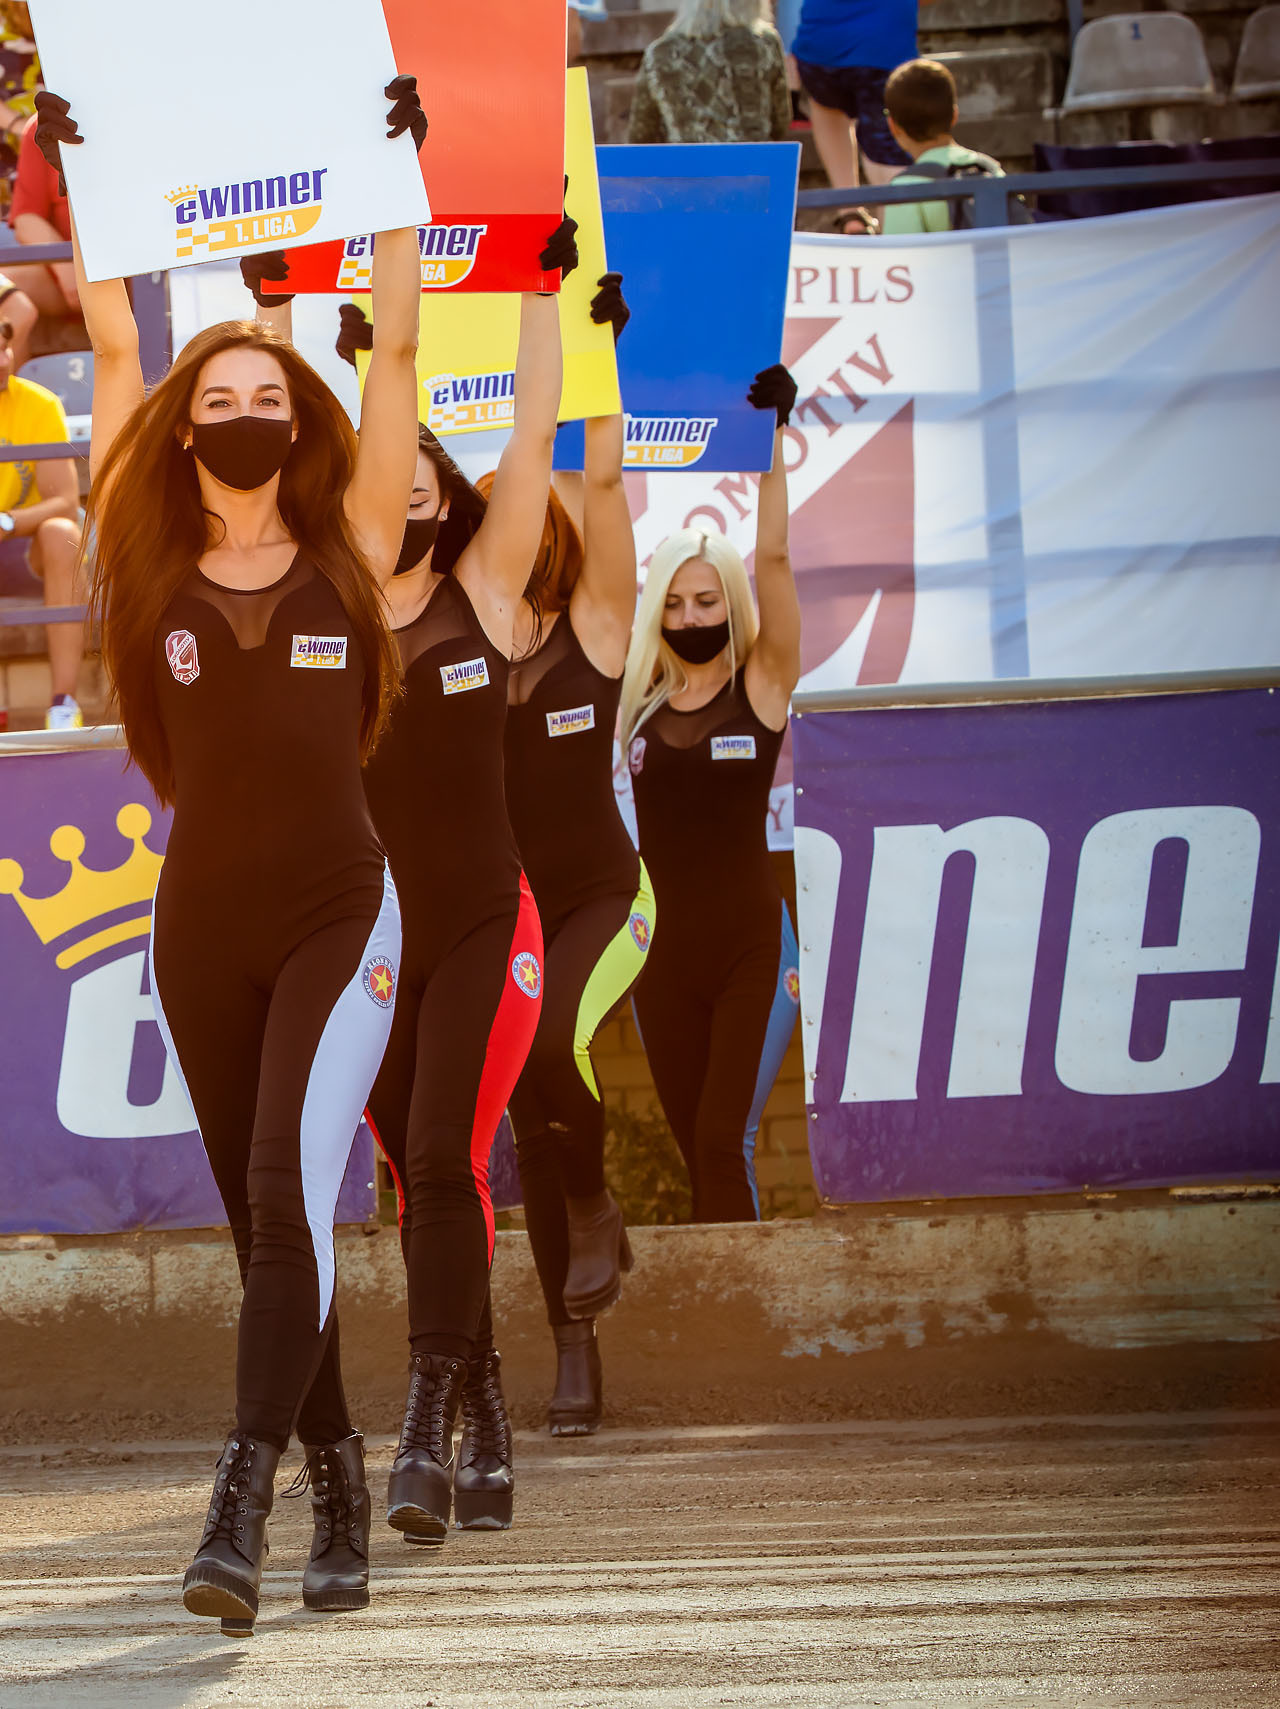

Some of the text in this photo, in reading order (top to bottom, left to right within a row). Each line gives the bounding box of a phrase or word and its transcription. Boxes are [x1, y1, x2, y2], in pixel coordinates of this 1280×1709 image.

[234, 215, 296, 242] 1. LIGA
[420, 263, 446, 281] GA
[792, 265, 915, 303] PILS
[69, 357, 85, 381] 3
[433, 373, 515, 405] eWinn
